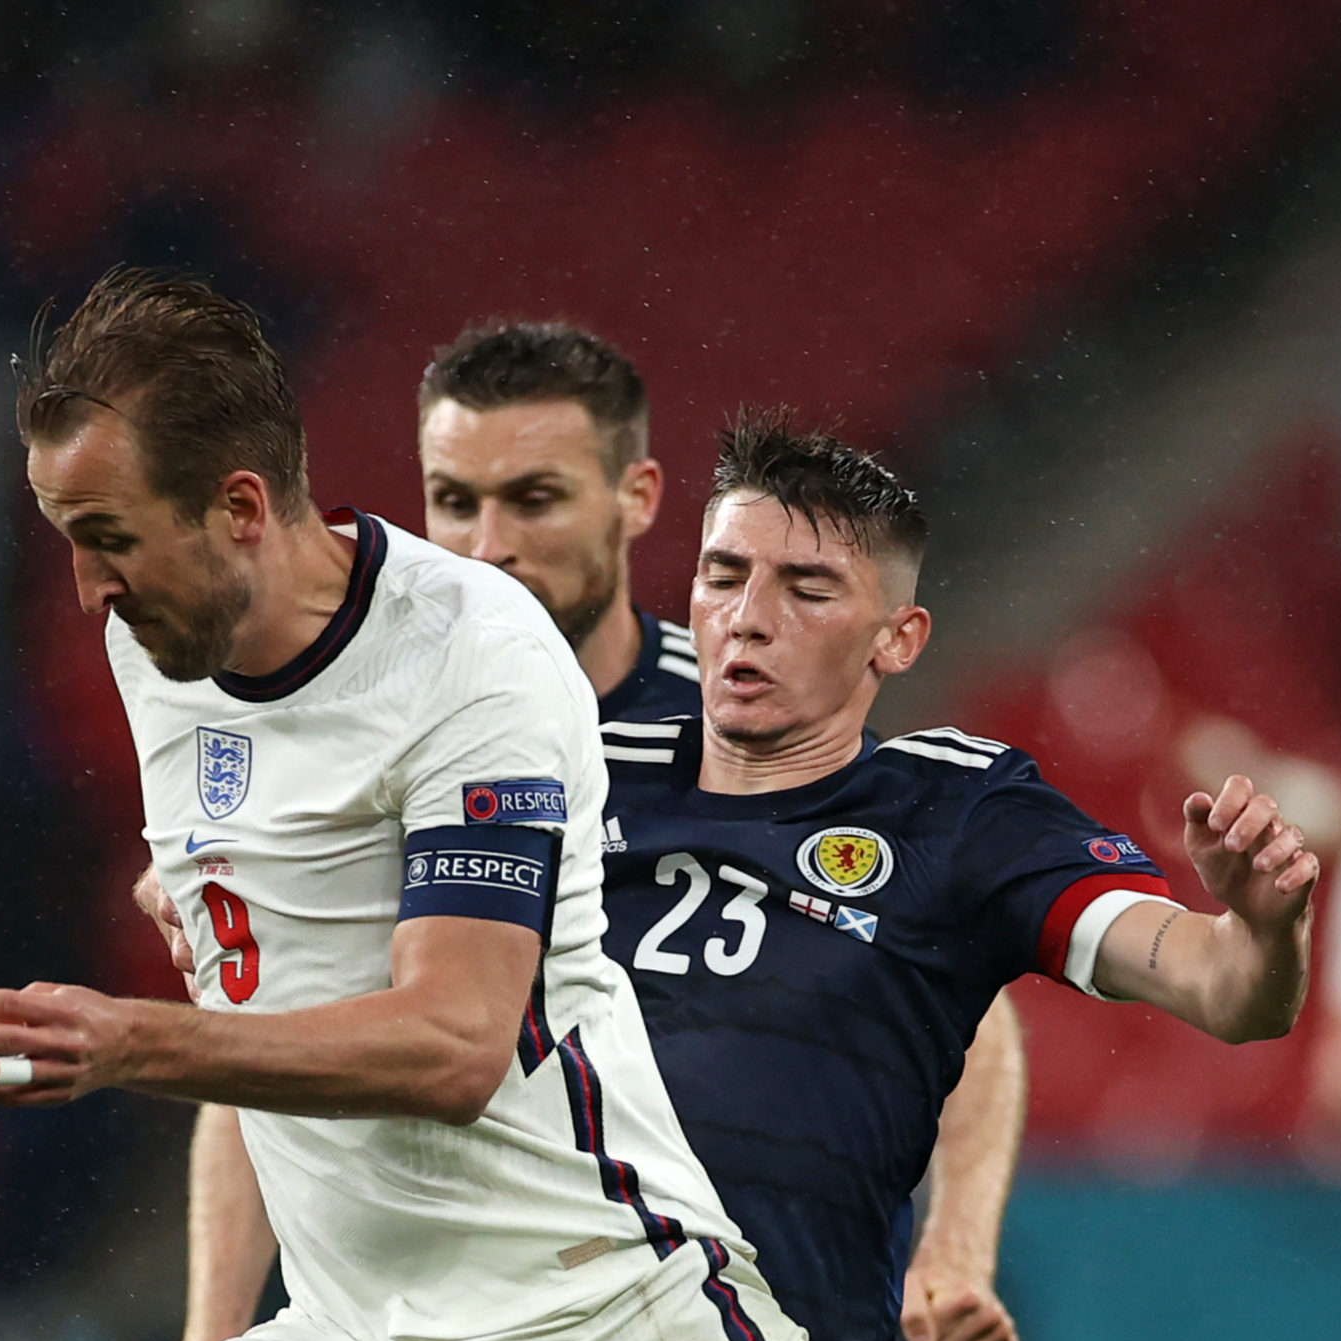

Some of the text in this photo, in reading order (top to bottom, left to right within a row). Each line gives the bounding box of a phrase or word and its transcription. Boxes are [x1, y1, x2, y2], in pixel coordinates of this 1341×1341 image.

[501, 791, 565, 812] RESPECT
[828, 828, 875, 839] SCOTLAND
[434, 857, 543, 889] RESPECT
[633, 852, 769, 976] 23
[201, 881, 260, 1004] 9
